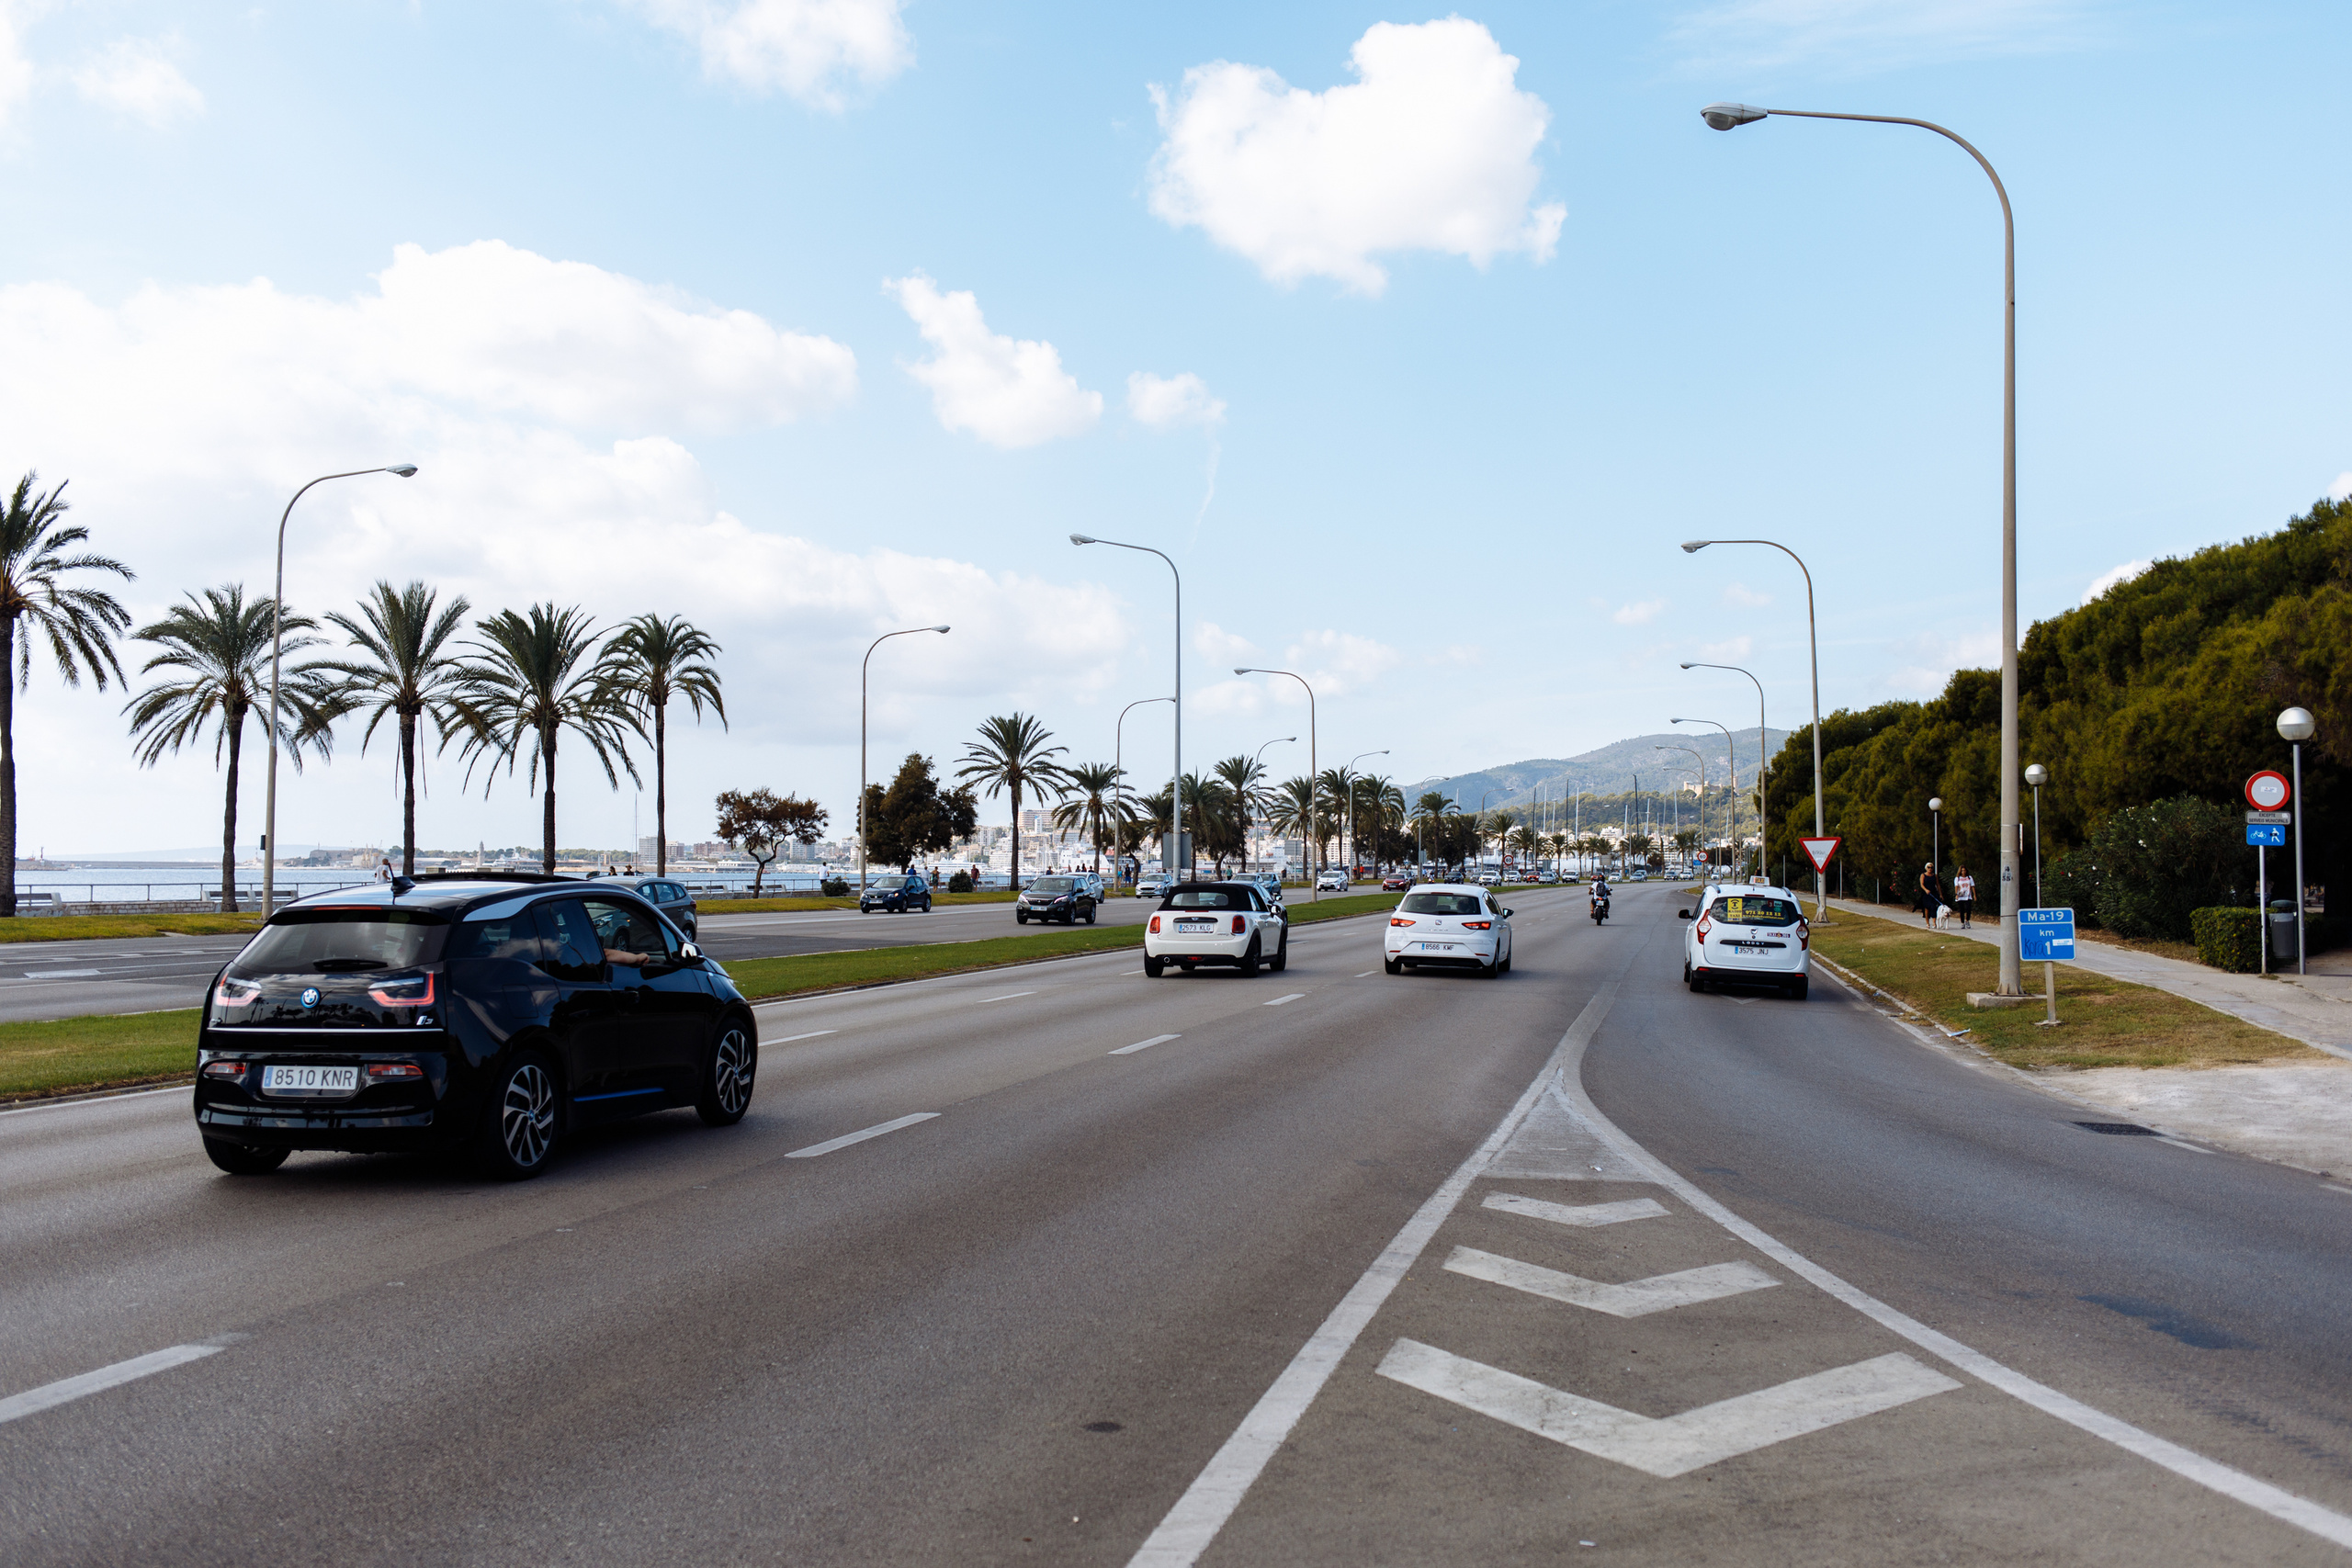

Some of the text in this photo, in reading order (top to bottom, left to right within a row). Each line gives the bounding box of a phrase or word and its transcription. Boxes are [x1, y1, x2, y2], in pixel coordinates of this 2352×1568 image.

[2028, 911, 2064, 921] Ma-19
[2045, 942, 2051, 954] 1
[275, 1069, 353, 1087] 8510 KNR
